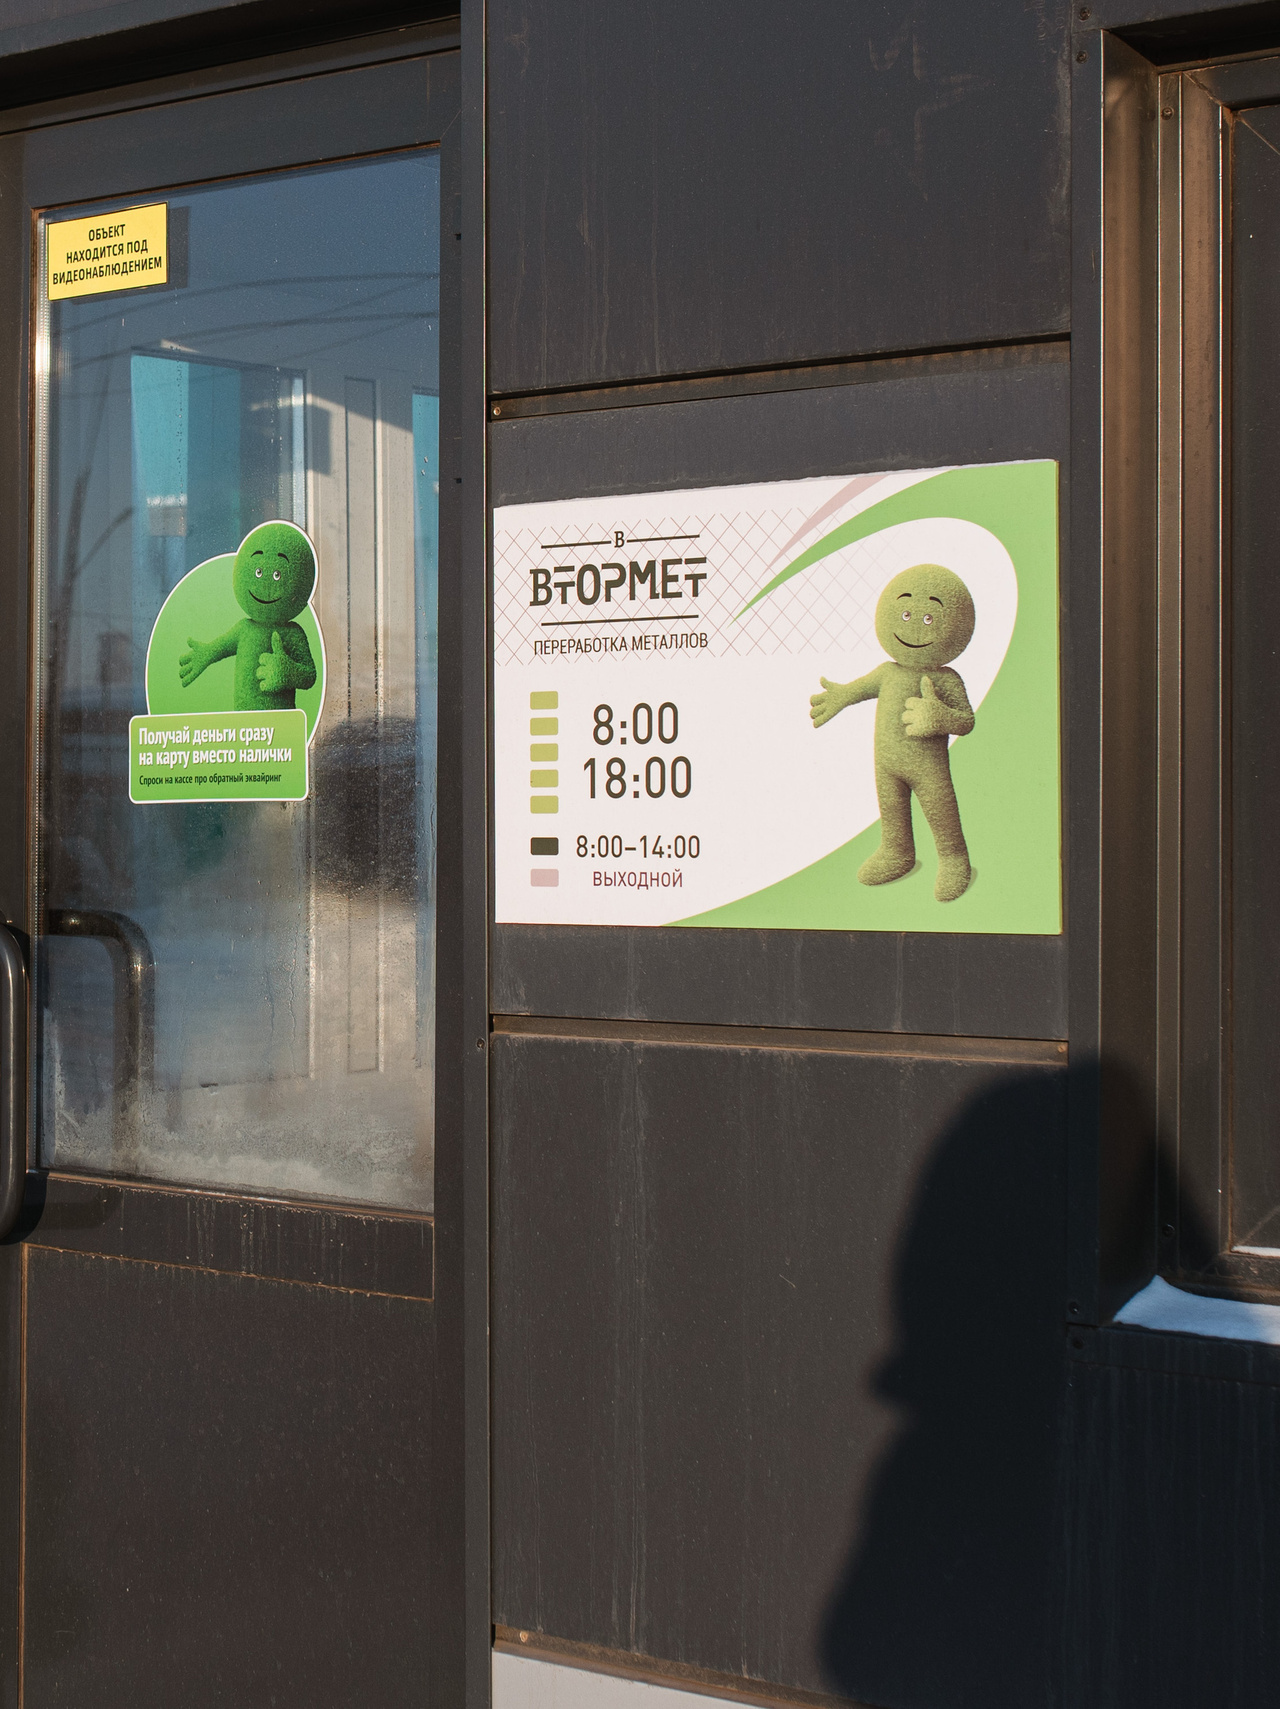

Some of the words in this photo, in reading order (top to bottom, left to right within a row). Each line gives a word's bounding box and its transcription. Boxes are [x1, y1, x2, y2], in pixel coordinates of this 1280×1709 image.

[88, 224, 126, 241] ОБЪЕКТ
[66, 243, 124, 264] НАХОДИТСЯ
[127, 239, 148, 254] ПОД
[52, 256, 162, 285] ВИДЕОНАБЛЮДЕНИЕМ
[529, 556, 708, 607] ВТОРМЕТ
[534, 636, 628, 655] ПЕРЕРАБОТКА
[631, 632, 708, 651] МЕТАЛЛОВ
[592, 701, 679, 746] 8:00
[139, 726, 190, 749] Получай
[192, 728, 237, 746] деньги
[239, 727, 275, 746] сразу
[139, 751, 153, 766] на
[156, 750, 191, 769] карту
[192, 748, 236, 764] вместо
[239, 747, 292, 763] налички
[139, 775, 164, 787] Спроси
[164, 776, 174, 784] на
[174, 775, 193, 784] кассе
[194, 775, 208, 786] про
[209, 772, 244, 785] обратный
[245, 772, 282, 785] эквайринг
[583, 755, 692, 799] 18:00
[592, 868, 683, 890] ВЫХОДНОЙ
